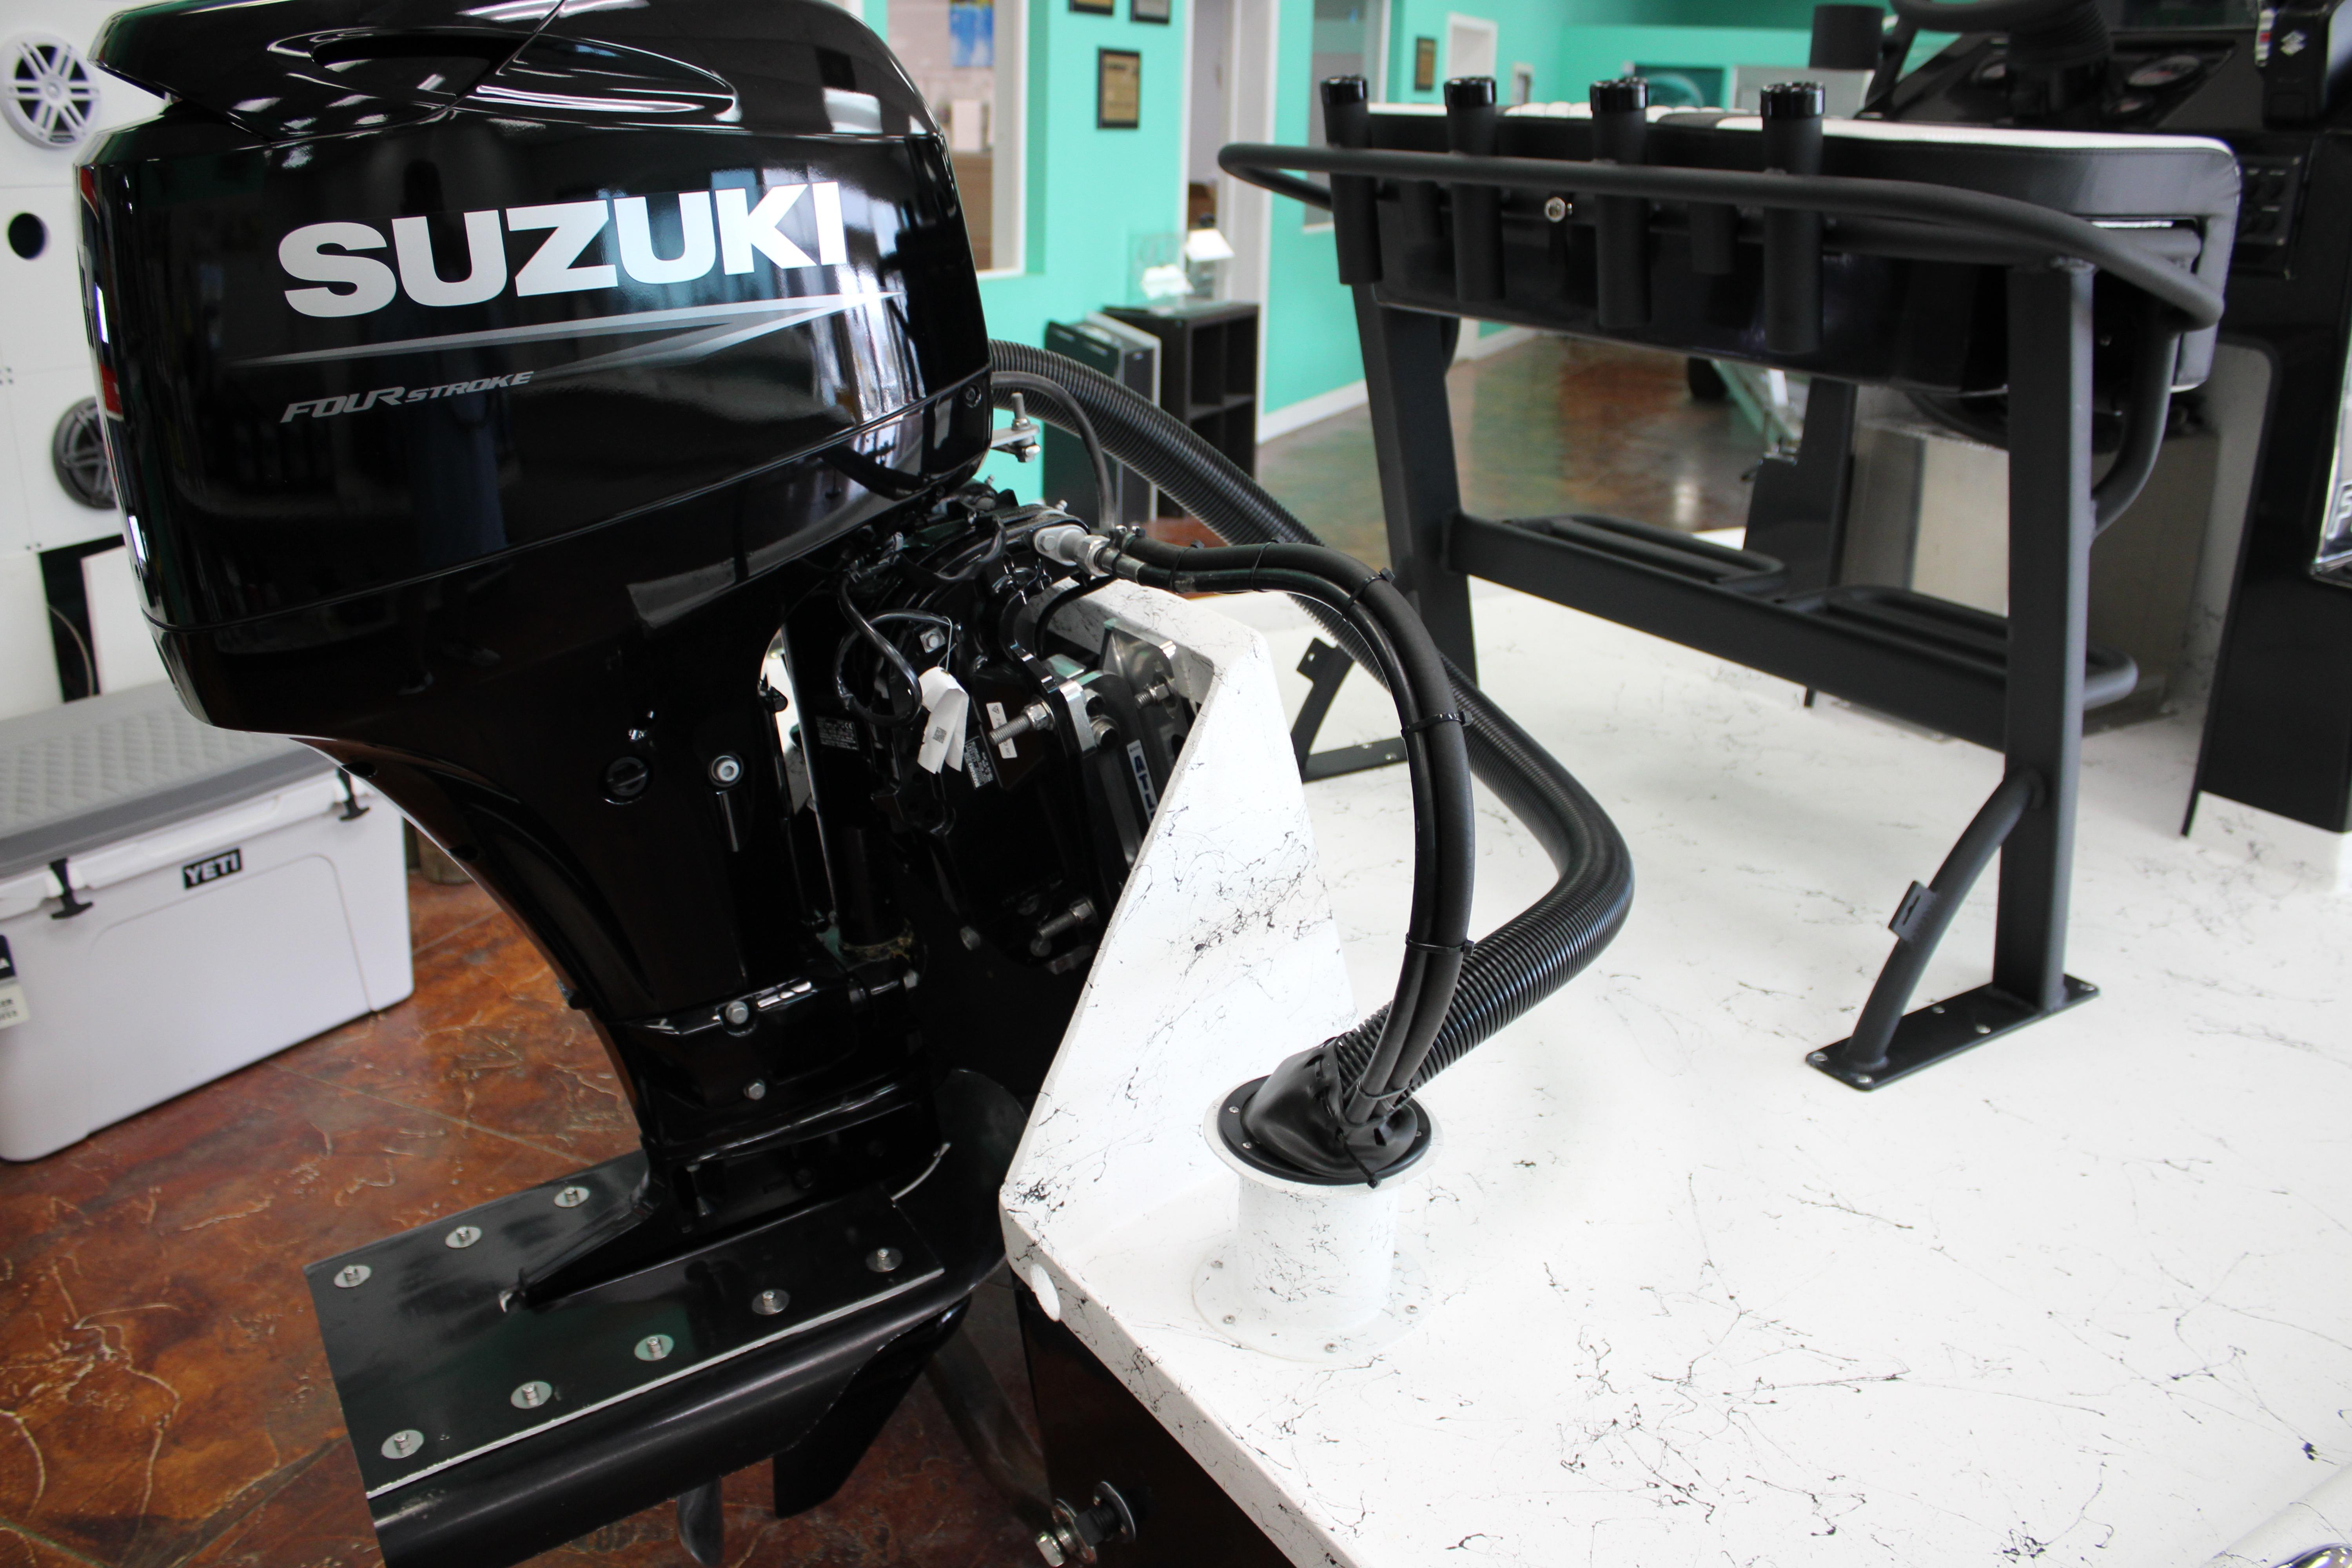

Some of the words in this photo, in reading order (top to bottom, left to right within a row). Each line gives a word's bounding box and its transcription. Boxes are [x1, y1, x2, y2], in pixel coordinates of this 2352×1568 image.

[278, 181, 848, 318] SUZUKI
[279, 386, 405, 423] FOUR
[403, 371, 534, 404] STROKE
[185, 852, 238, 884] YETI
